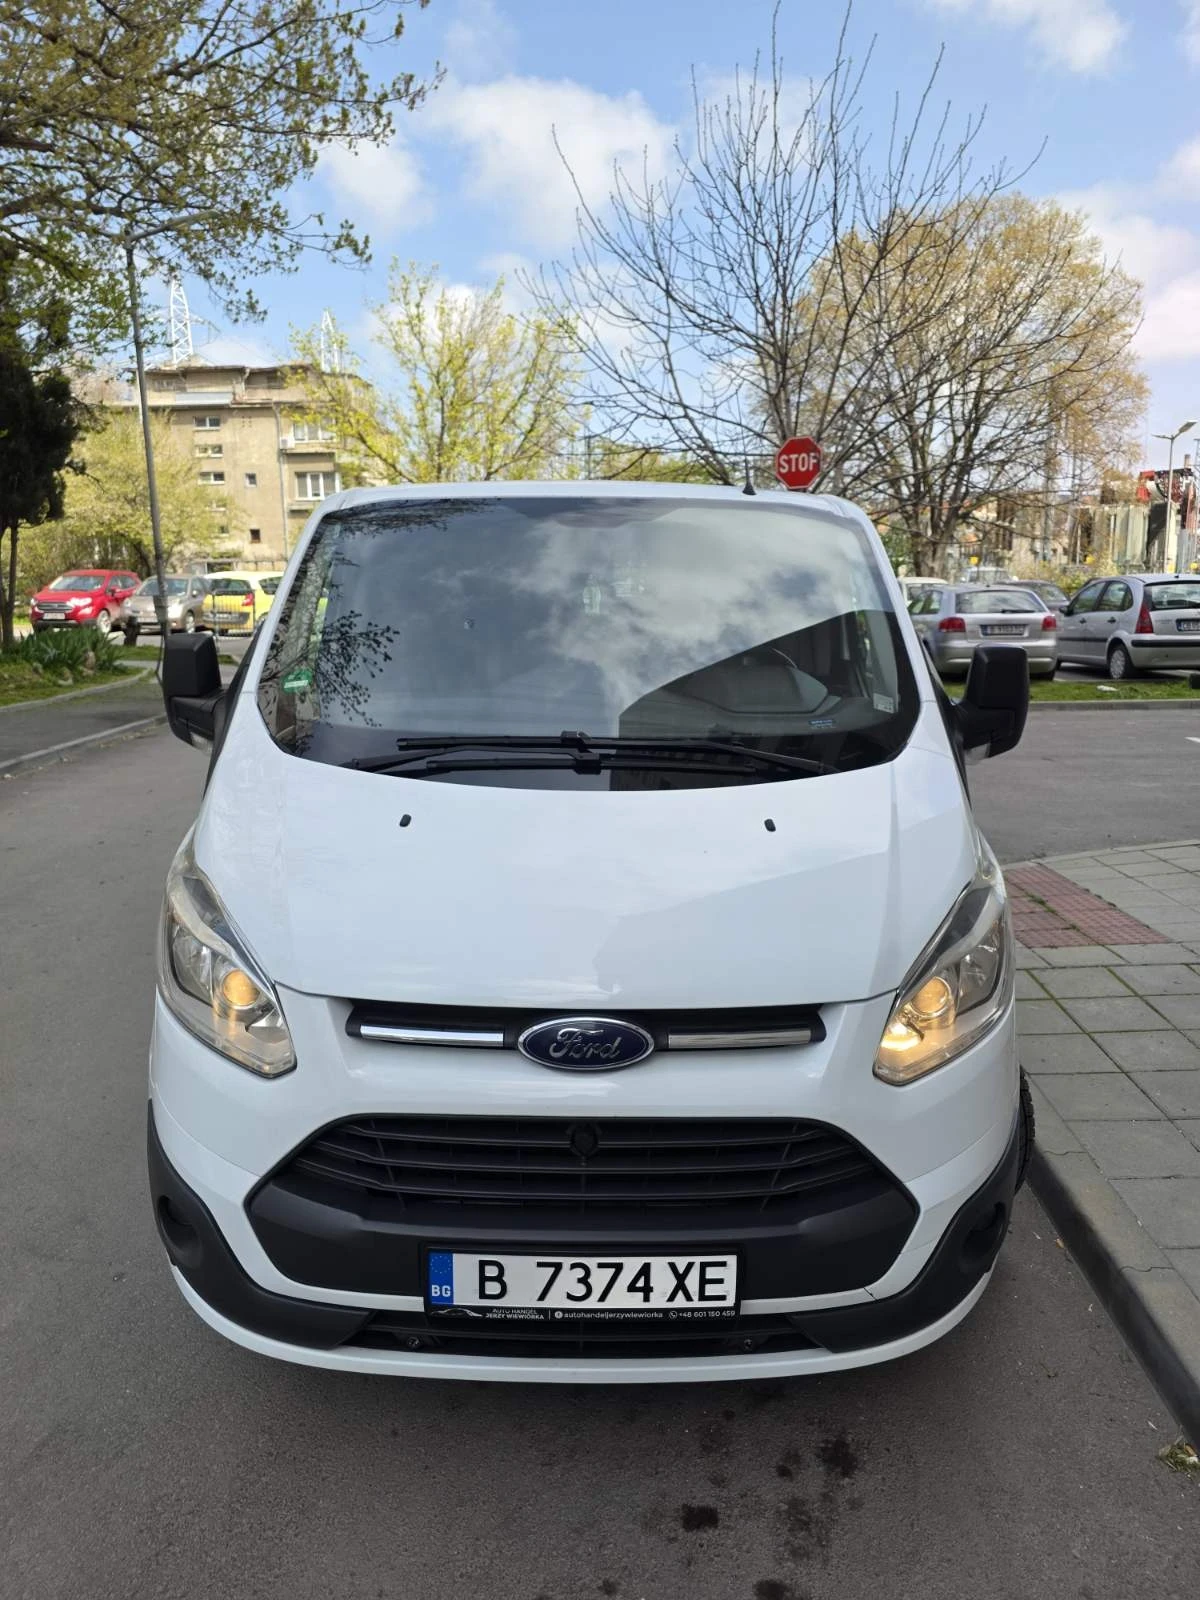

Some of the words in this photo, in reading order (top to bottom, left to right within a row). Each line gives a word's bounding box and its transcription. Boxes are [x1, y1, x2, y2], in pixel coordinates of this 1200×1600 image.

[779, 452, 819, 474] STOP
[550, 1027, 622, 1059] Ford
[431, 1284, 451, 1297] BG
[478, 1259, 508, 1300] B
[536, 1261, 654, 1303] 7374
[665, 1260, 728, 1303] XE
